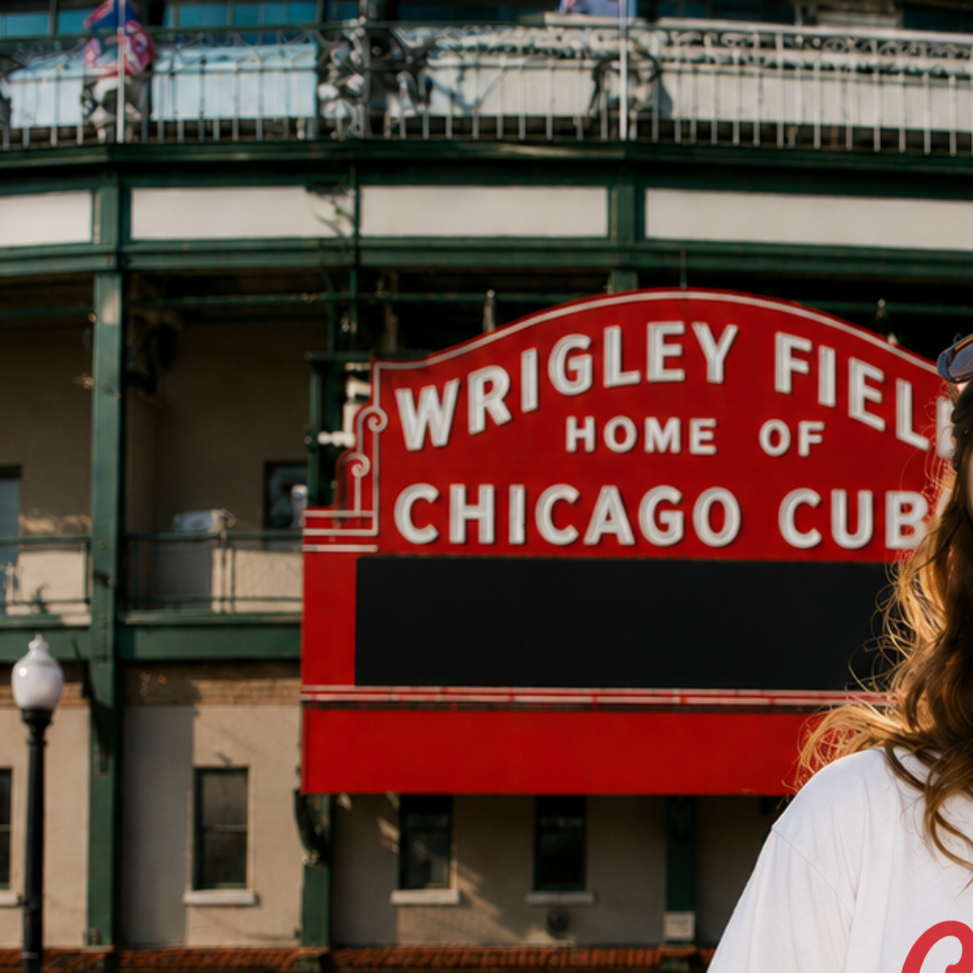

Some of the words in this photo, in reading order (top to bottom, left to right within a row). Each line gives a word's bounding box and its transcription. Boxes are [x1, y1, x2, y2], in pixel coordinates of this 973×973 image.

[395, 321, 739, 452] WRIGLEY
[564, 416, 717, 456] HOME
[758, 418, 825, 457] OF
[393, 483, 741, 549] CHICAGO
[776, 488, 951, 551] CUB
